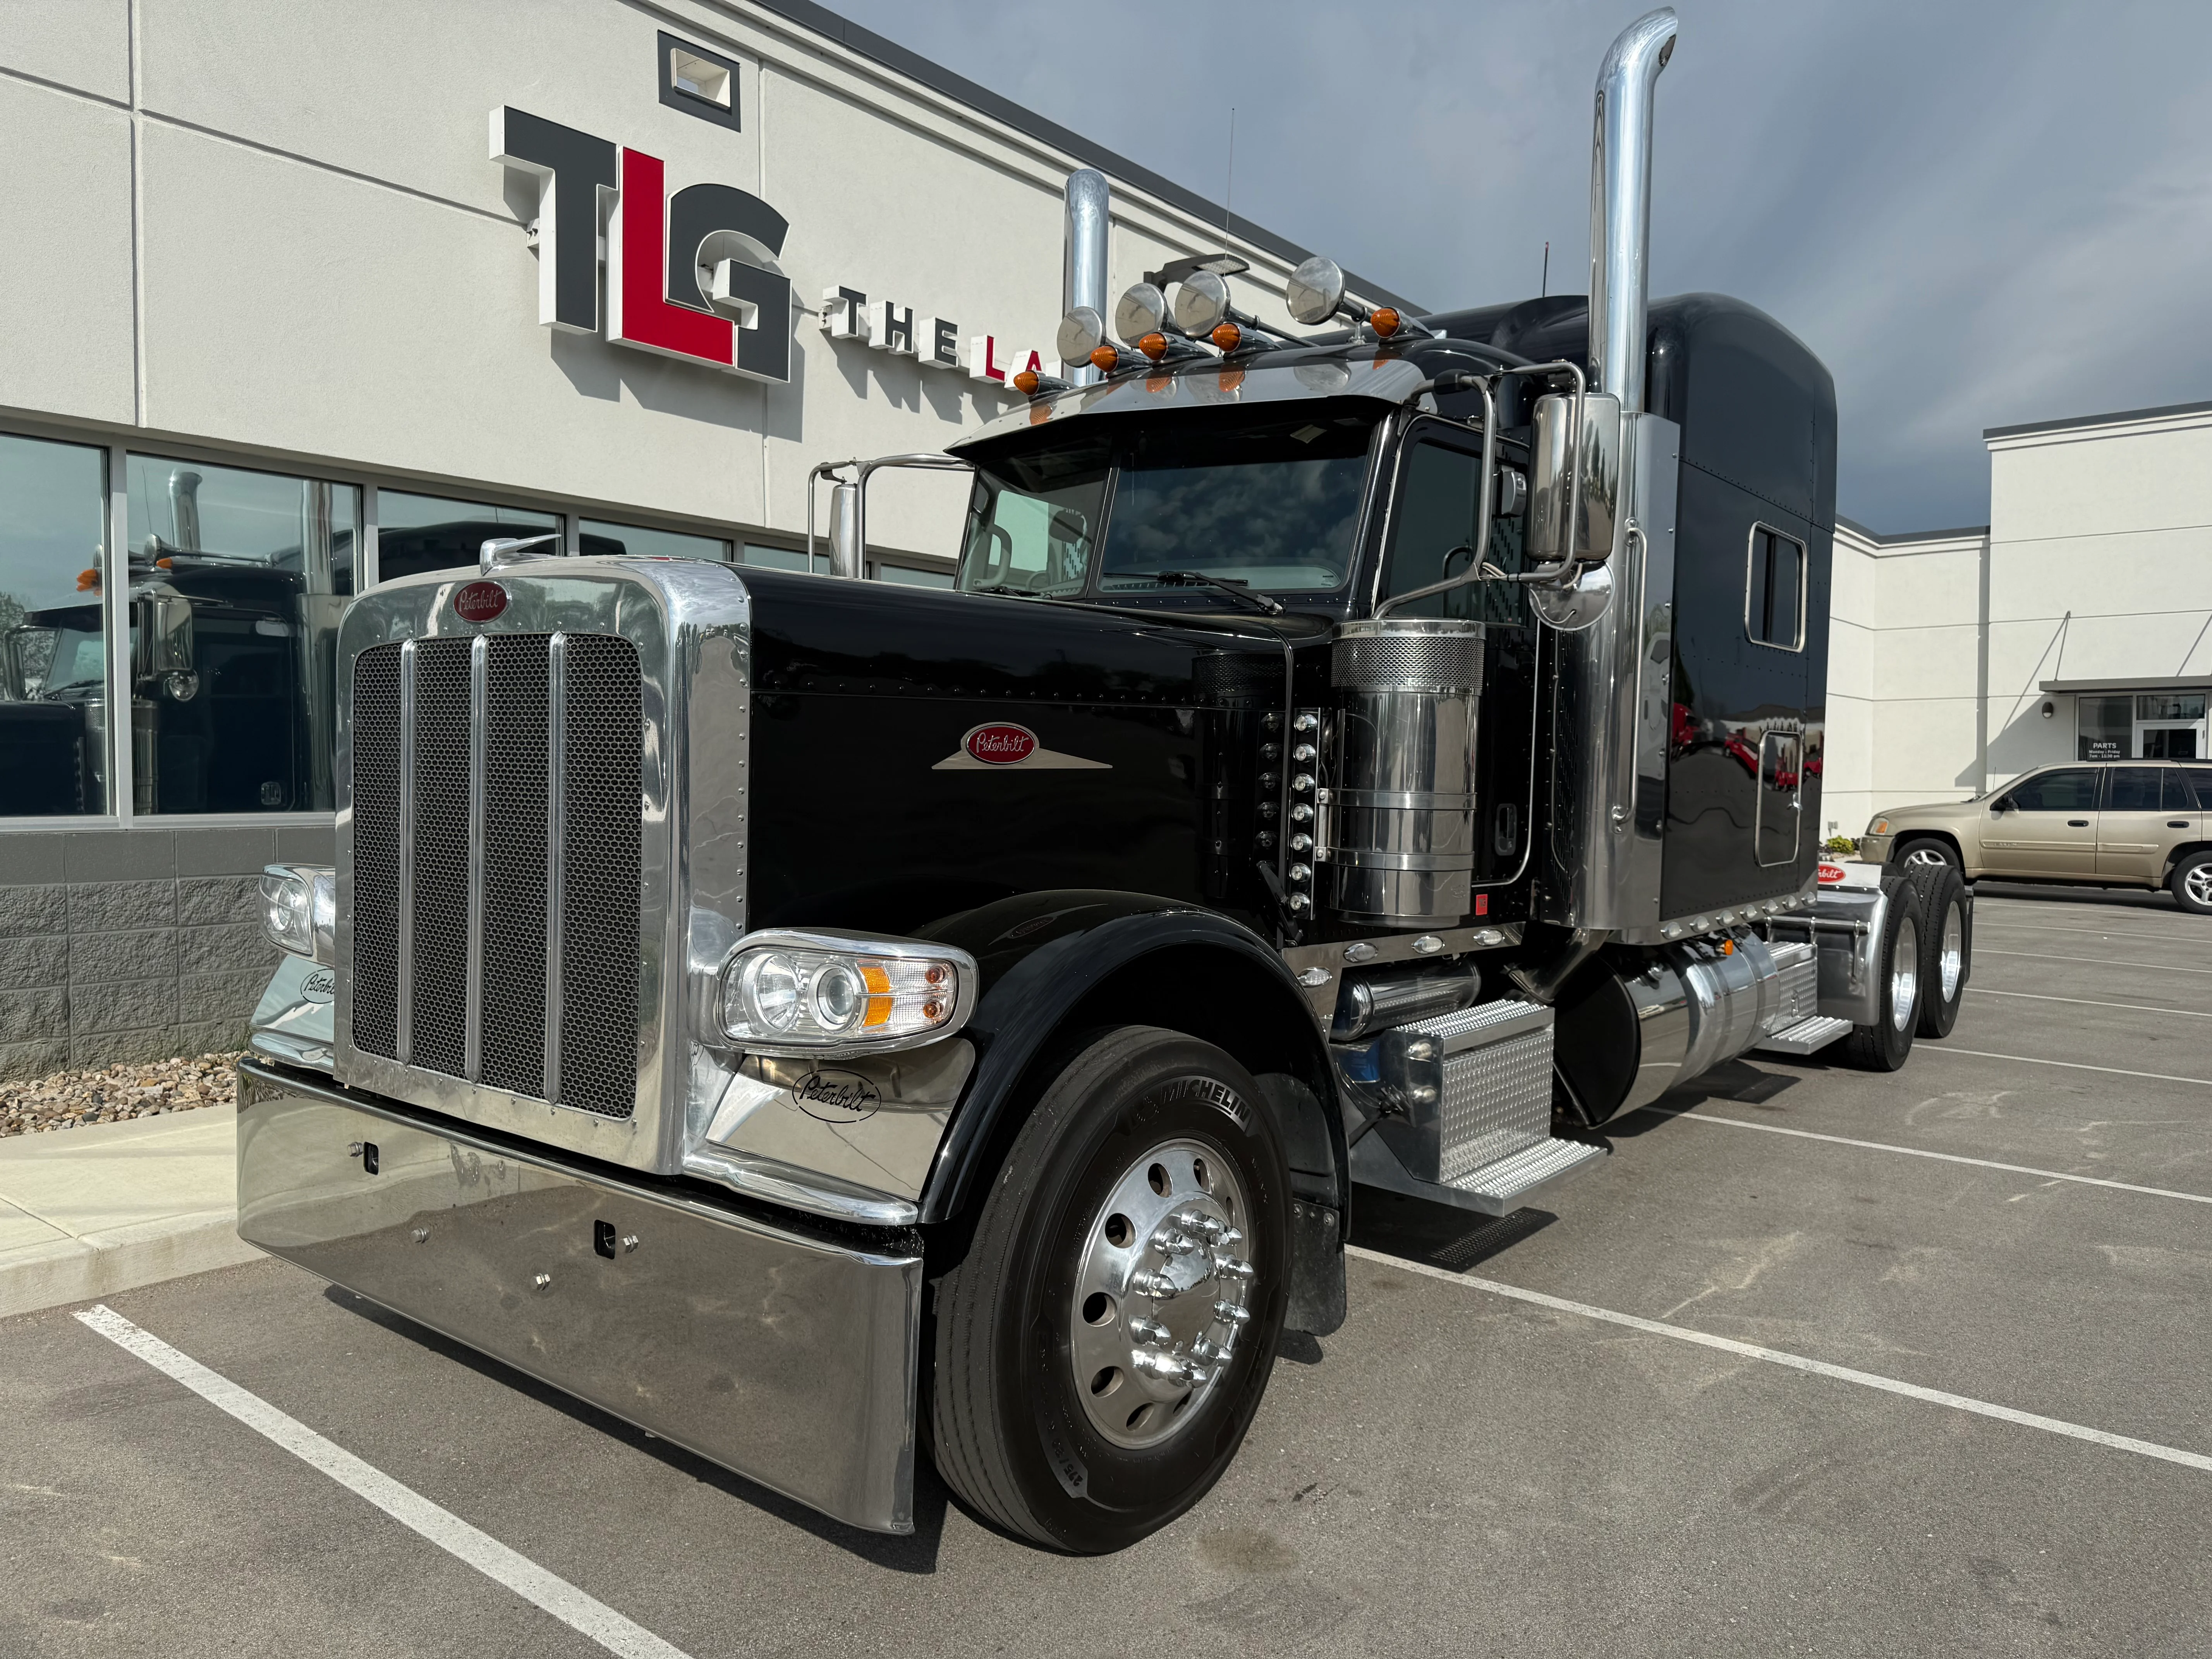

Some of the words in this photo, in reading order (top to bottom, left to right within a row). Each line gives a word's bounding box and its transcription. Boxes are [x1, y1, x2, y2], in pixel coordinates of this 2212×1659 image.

[489, 105, 792, 383] TLG
[823, 285, 958, 369] THE
[459, 589, 502, 612] Peterbilt
[976, 732, 1029, 753] Peterbilt
[799, 1075, 876, 1112] Peterbilt
[1159, 1079, 1251, 1123] MICHELIN
